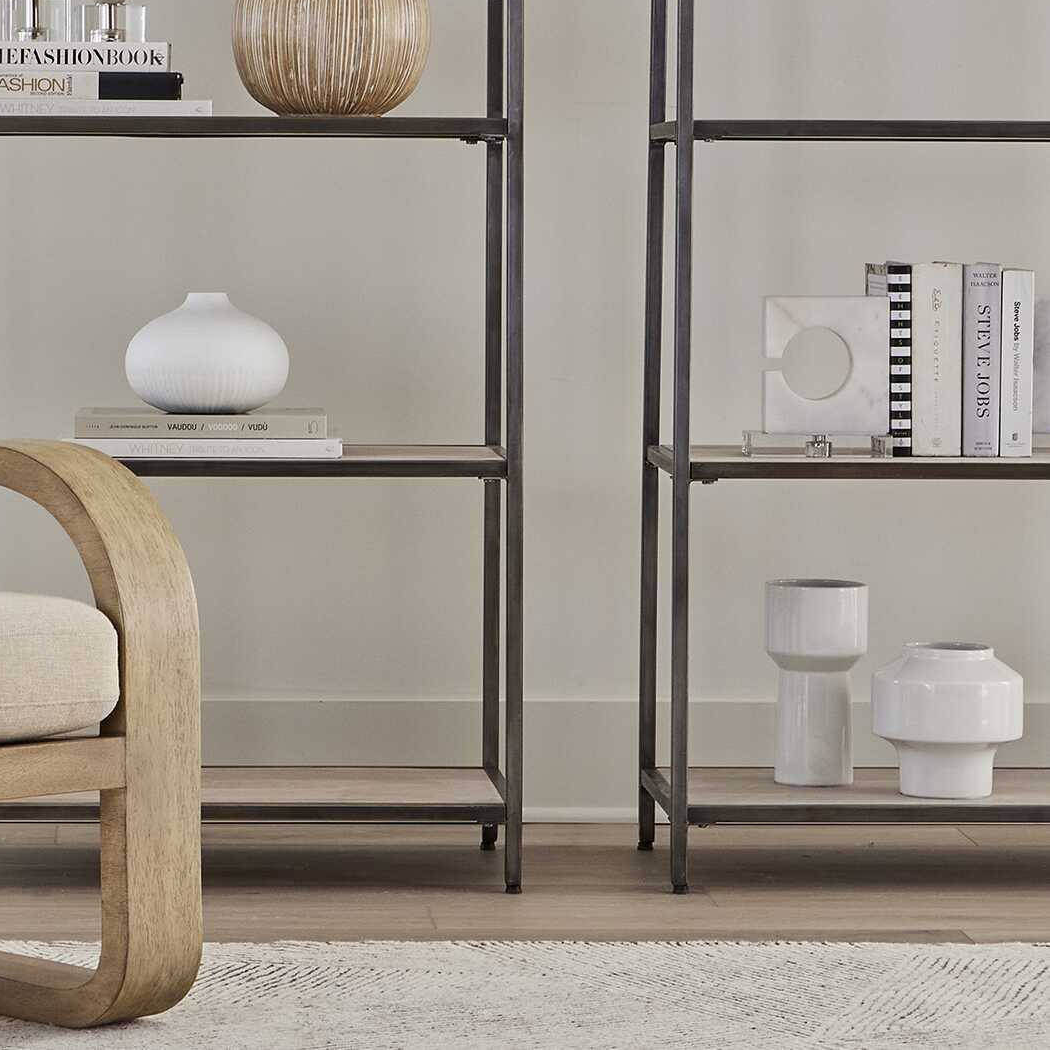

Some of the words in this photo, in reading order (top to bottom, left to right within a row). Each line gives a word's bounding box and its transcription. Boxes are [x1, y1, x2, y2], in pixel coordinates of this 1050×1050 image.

[977, 305, 991, 367] STEVE
[1013, 323, 1021, 341] Jobs
[976, 373, 991, 418] JOBS
[166, 423, 197, 431] VAUDOU
